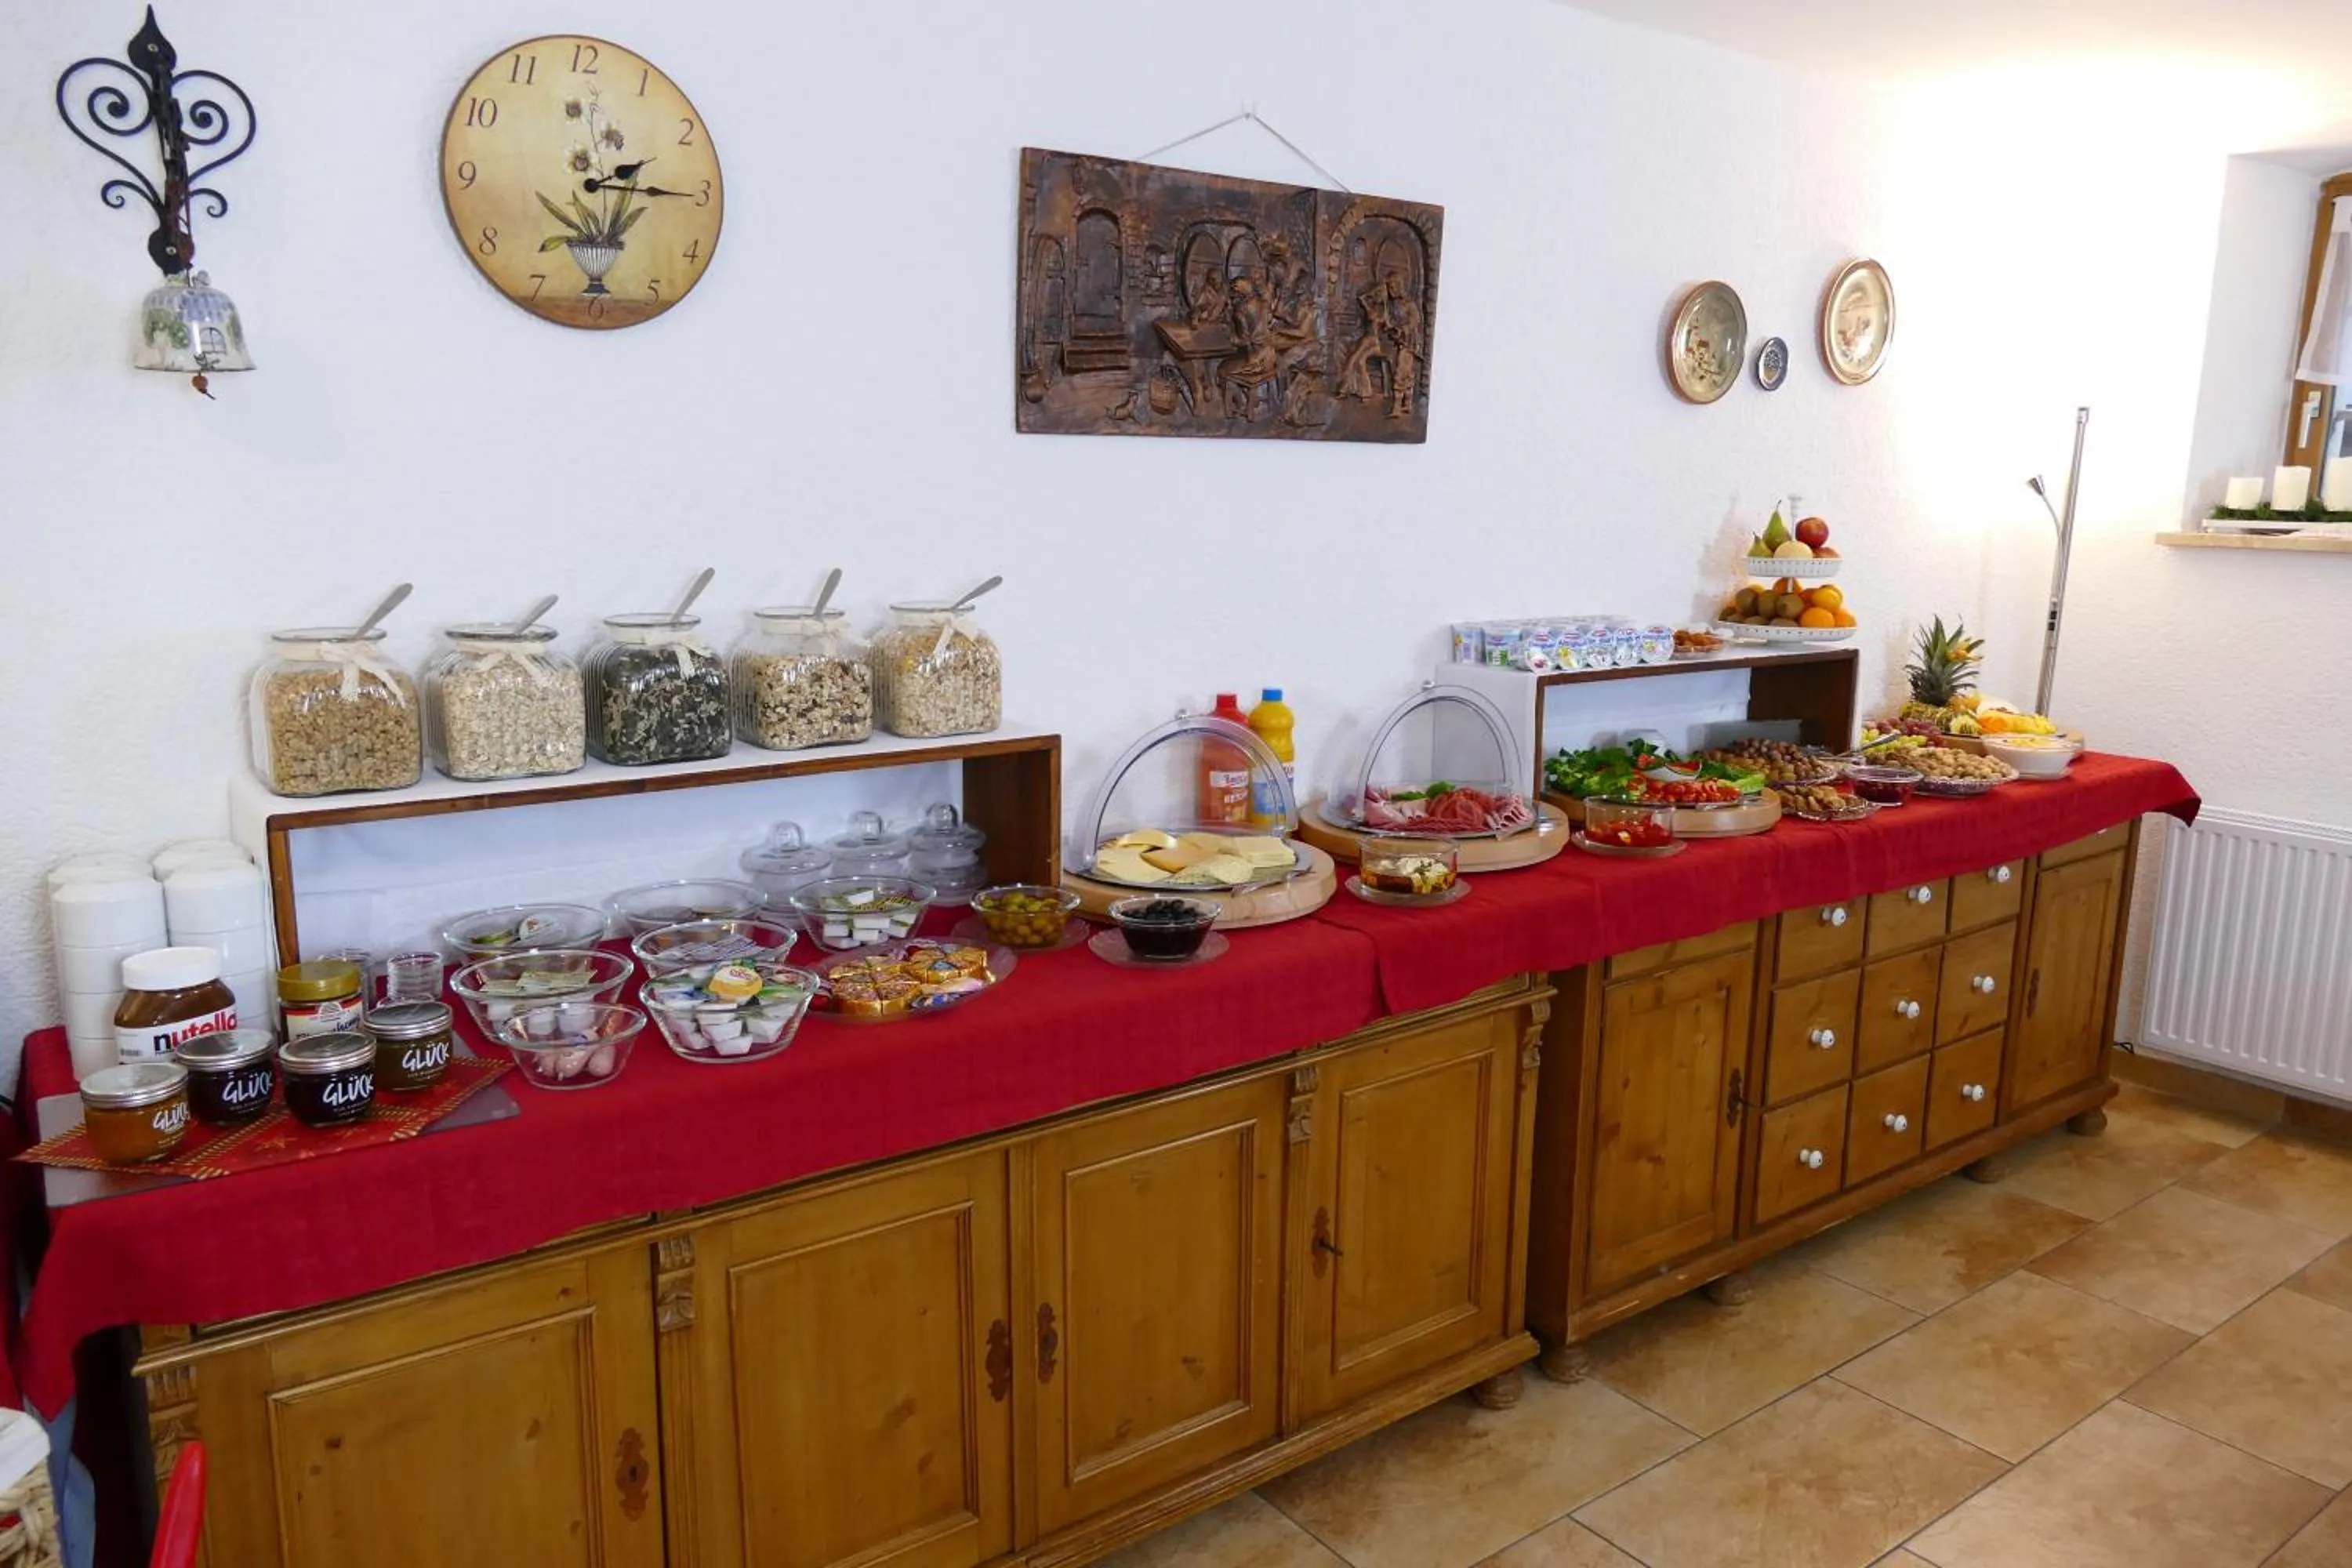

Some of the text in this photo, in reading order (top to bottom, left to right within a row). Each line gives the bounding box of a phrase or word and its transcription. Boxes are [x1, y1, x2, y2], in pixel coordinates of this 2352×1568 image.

[508, 54, 537, 85] 11
[572, 45, 599, 74] 12
[637, 68, 649, 97] 1
[466, 97, 498, 128] 10
[677, 118, 695, 146] 2
[458, 161, 477, 191] 9
[695, 180, 712, 207] 3
[479, 227, 499, 256] 8
[682, 239, 699, 264] 4
[529, 274, 546, 302] 7
[644, 279, 661, 306] 5
[588, 297, 604, 321] 6
[153, 1011, 238, 1051] nutella
[402, 1042, 449, 1072] GLÜCK
